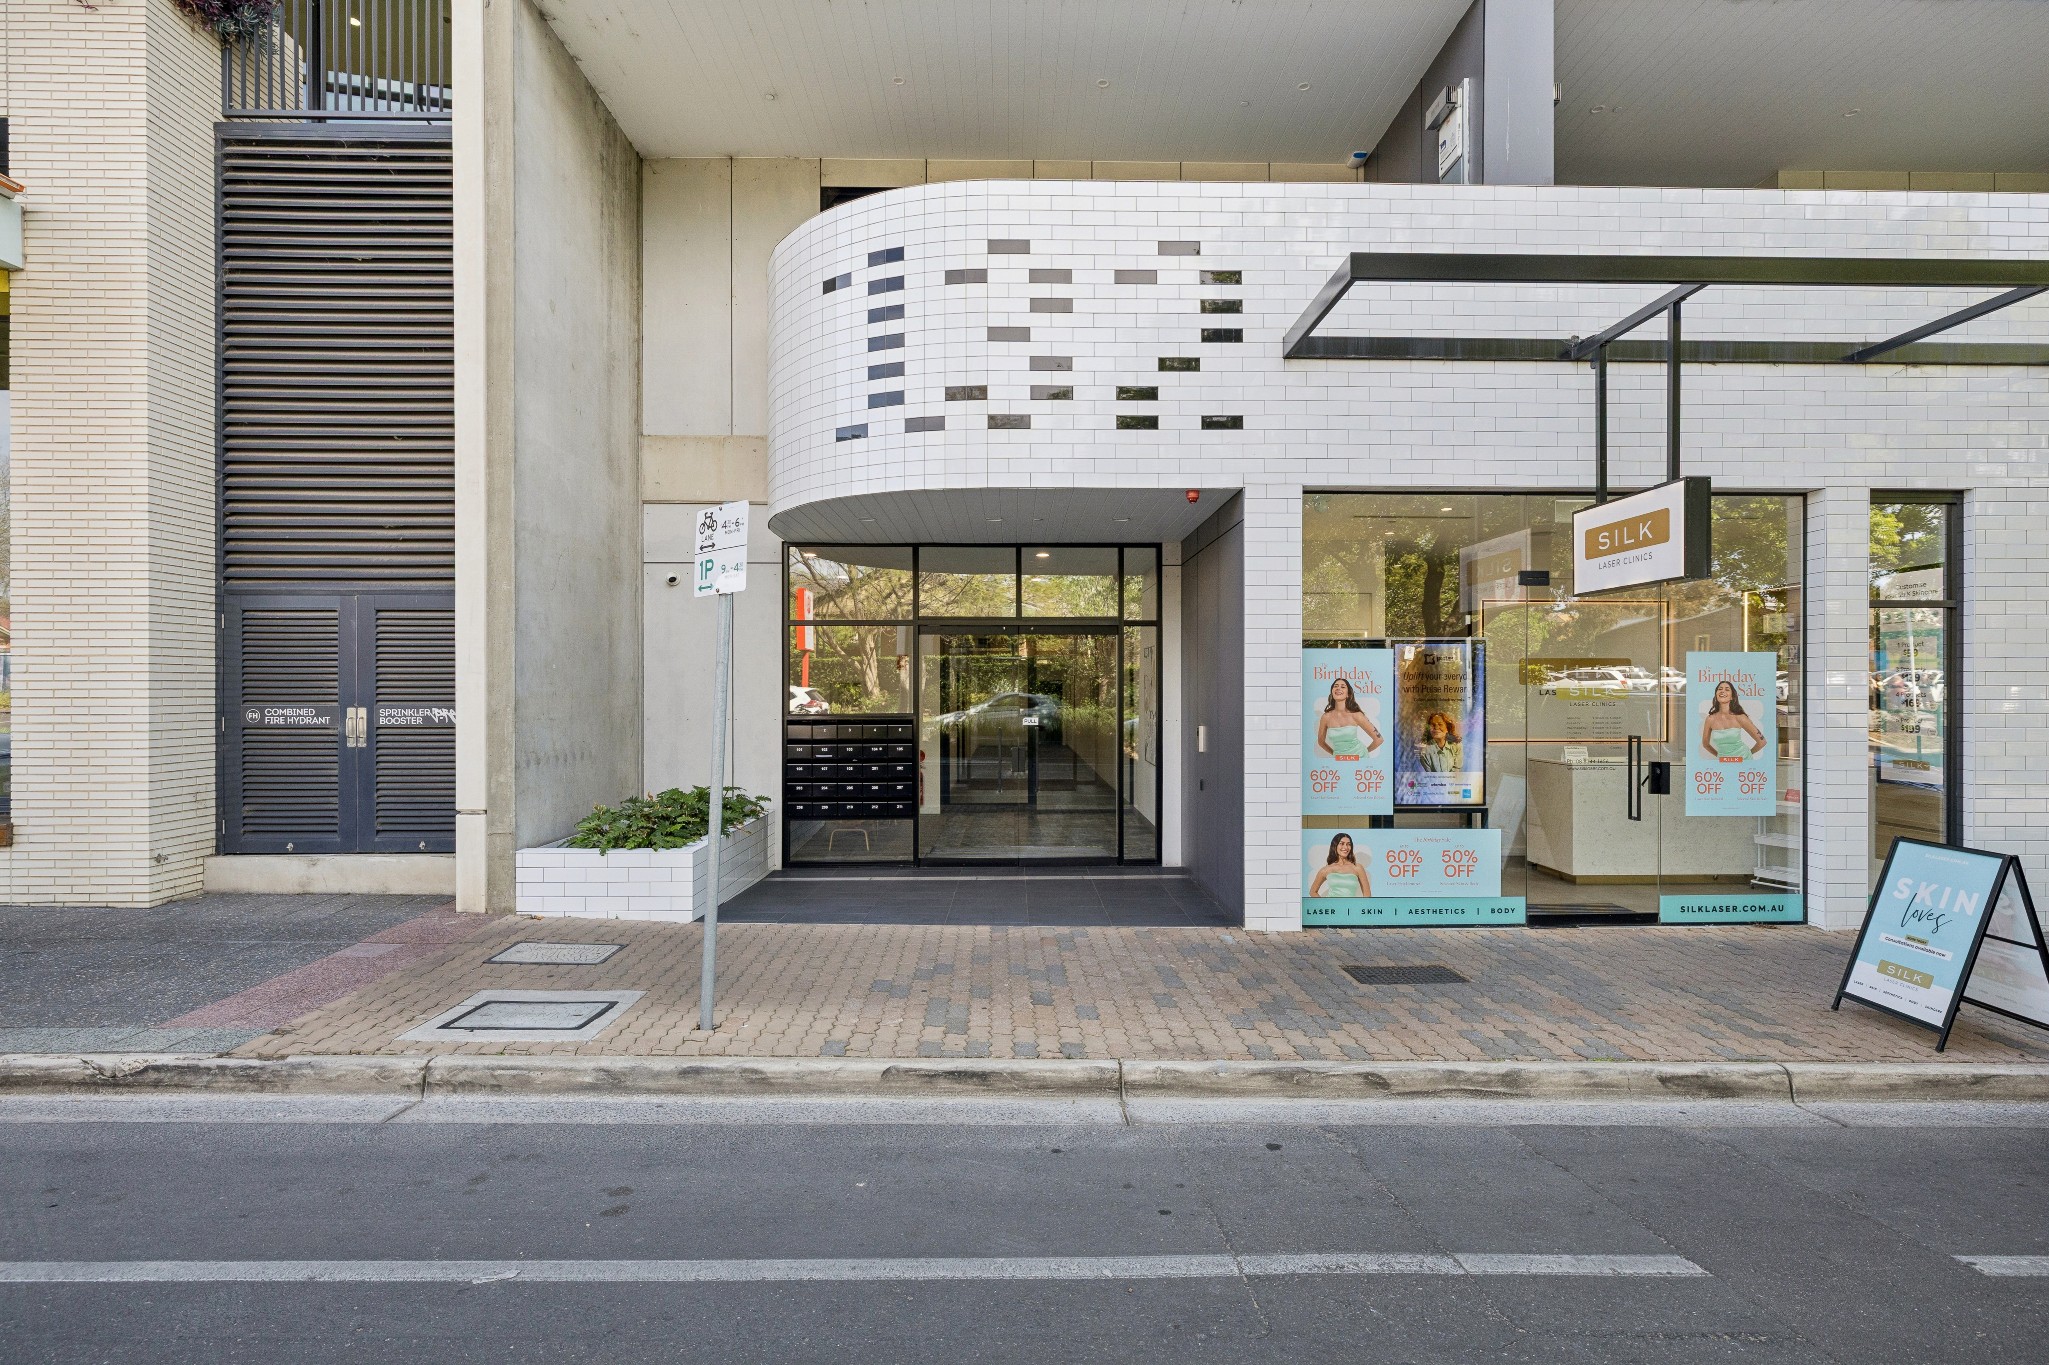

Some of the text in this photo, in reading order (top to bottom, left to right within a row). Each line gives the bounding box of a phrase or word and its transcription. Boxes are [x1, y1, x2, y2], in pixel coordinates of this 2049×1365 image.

[1598, 520, 1653, 550] SILK
[1598, 552, 1653, 570] LASER CLINICS
[700, 558, 714, 580] 1P
[1314, 666, 1373, 680] Birthday
[1403, 672, 1424, 682] Uplift
[1444, 672, 1468, 682] everyd
[1698, 669, 1756, 683] Birthday
[1353, 680, 1383, 694] Sale
[1444, 685, 1467, 693] Rewar
[1738, 684, 1766, 697] Sale
[379, 708, 430, 716] SPRINKLER
[264, 716, 330, 724] FIRE HYDRANT
[1310, 770, 1340, 781] 60%
[1354, 770, 1384, 781] 50%
[1694, 772, 1724, 782] 60%
[1738, 772, 1768, 782] 50%
[1312, 782, 1338, 792] OFF
[1356, 782, 1382, 792] OFF
[1696, 784, 1722, 794] OFF
[1740, 784, 1765, 794] OFF
[1386, 850, 1423, 863] 60%
[1442, 850, 1478, 863] 50%
[1388, 864, 1420, 878] OFF
[1444, 864, 1476, 878] OFF
[1892, 878, 1980, 916] SKIN
[1901, 892, 1952, 934] loves
[1886, 966, 1922, 984] SILK
